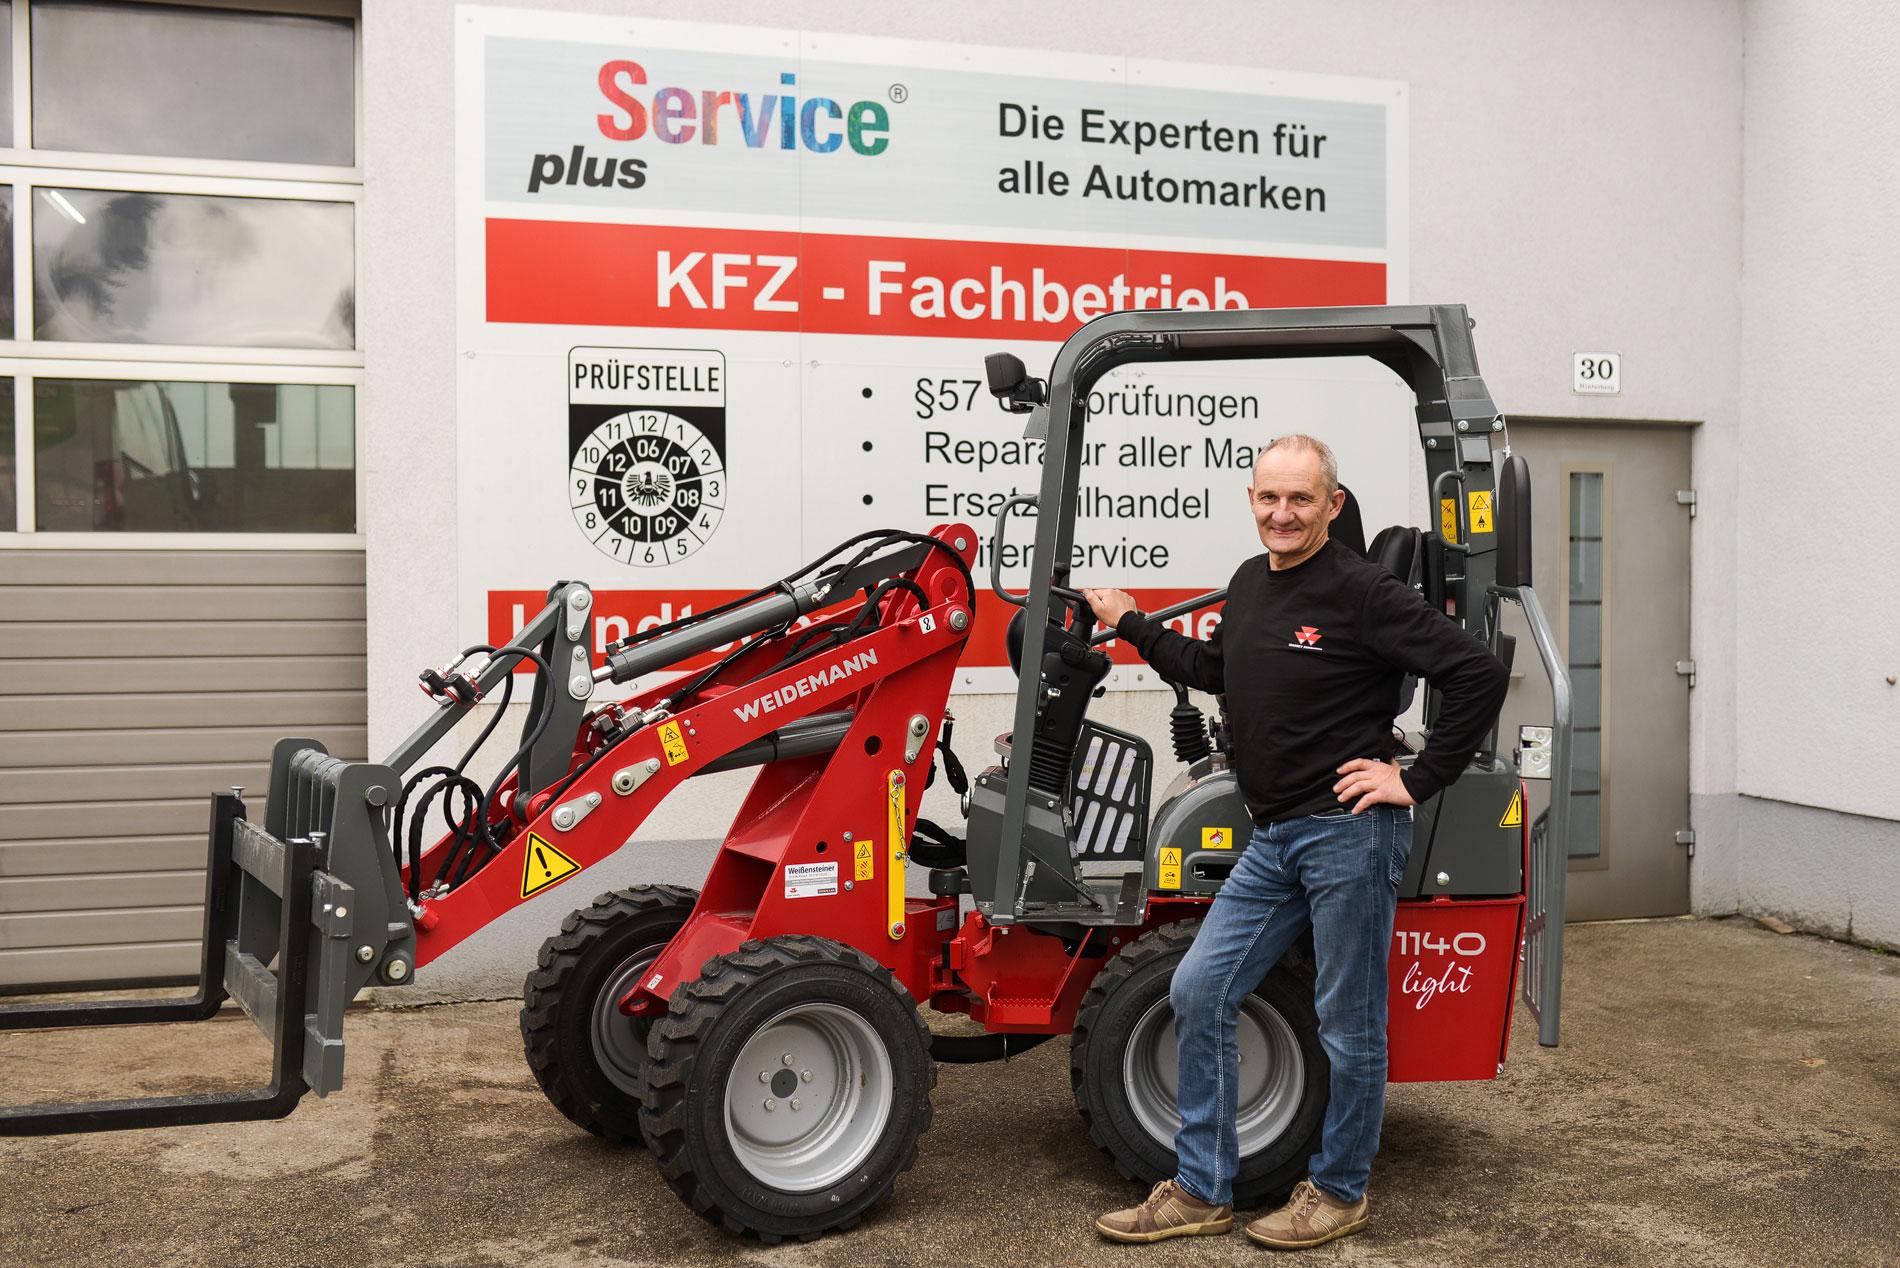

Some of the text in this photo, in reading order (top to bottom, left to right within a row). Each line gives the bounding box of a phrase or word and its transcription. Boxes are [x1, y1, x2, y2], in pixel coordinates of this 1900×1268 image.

[597, 59, 890, 156] Service
[999, 102, 1327, 159] Die Experten für
[527, 145, 648, 193] plus
[998, 160, 1327, 212] alle Automarken
[657, 250, 799, 312] KFZ
[868, 259, 1250, 325] Fachbetrieb
[575, 359, 719, 392] PRÜFSTELLE
[1581, 358, 1613, 379] 30
[915, 377, 982, 420] §57
[605, 423, 621, 440] 11
[639, 416, 657, 432] 12
[676, 424, 683, 440] 1
[581, 447, 599, 464] 10
[637, 439, 659, 458] 06
[702, 449, 711, 466] 2
[1119, 436, 1192, 468] aller
[606, 453, 626, 472] 12
[669, 456, 691, 475] 07
[577, 479, 587, 496] 9
[709, 481, 719, 497] 3
[599, 488, 616, 507] 11
[677, 488, 699, 508] 08
[585, 512, 596, 529] 8
[621, 516, 641, 535] 10
[655, 516, 677, 535] 09
[699, 513, 710, 529] 4
[611, 539, 622, 555] 7
[644, 547, 654, 563] 6
[677, 539, 687, 555] 5
[733, 647, 878, 723] WEIDEMANN
[788, 865, 835, 875] Weißensteiner
[1396, 931, 1486, 956] 1140
[1402, 961, 1473, 1010] light
